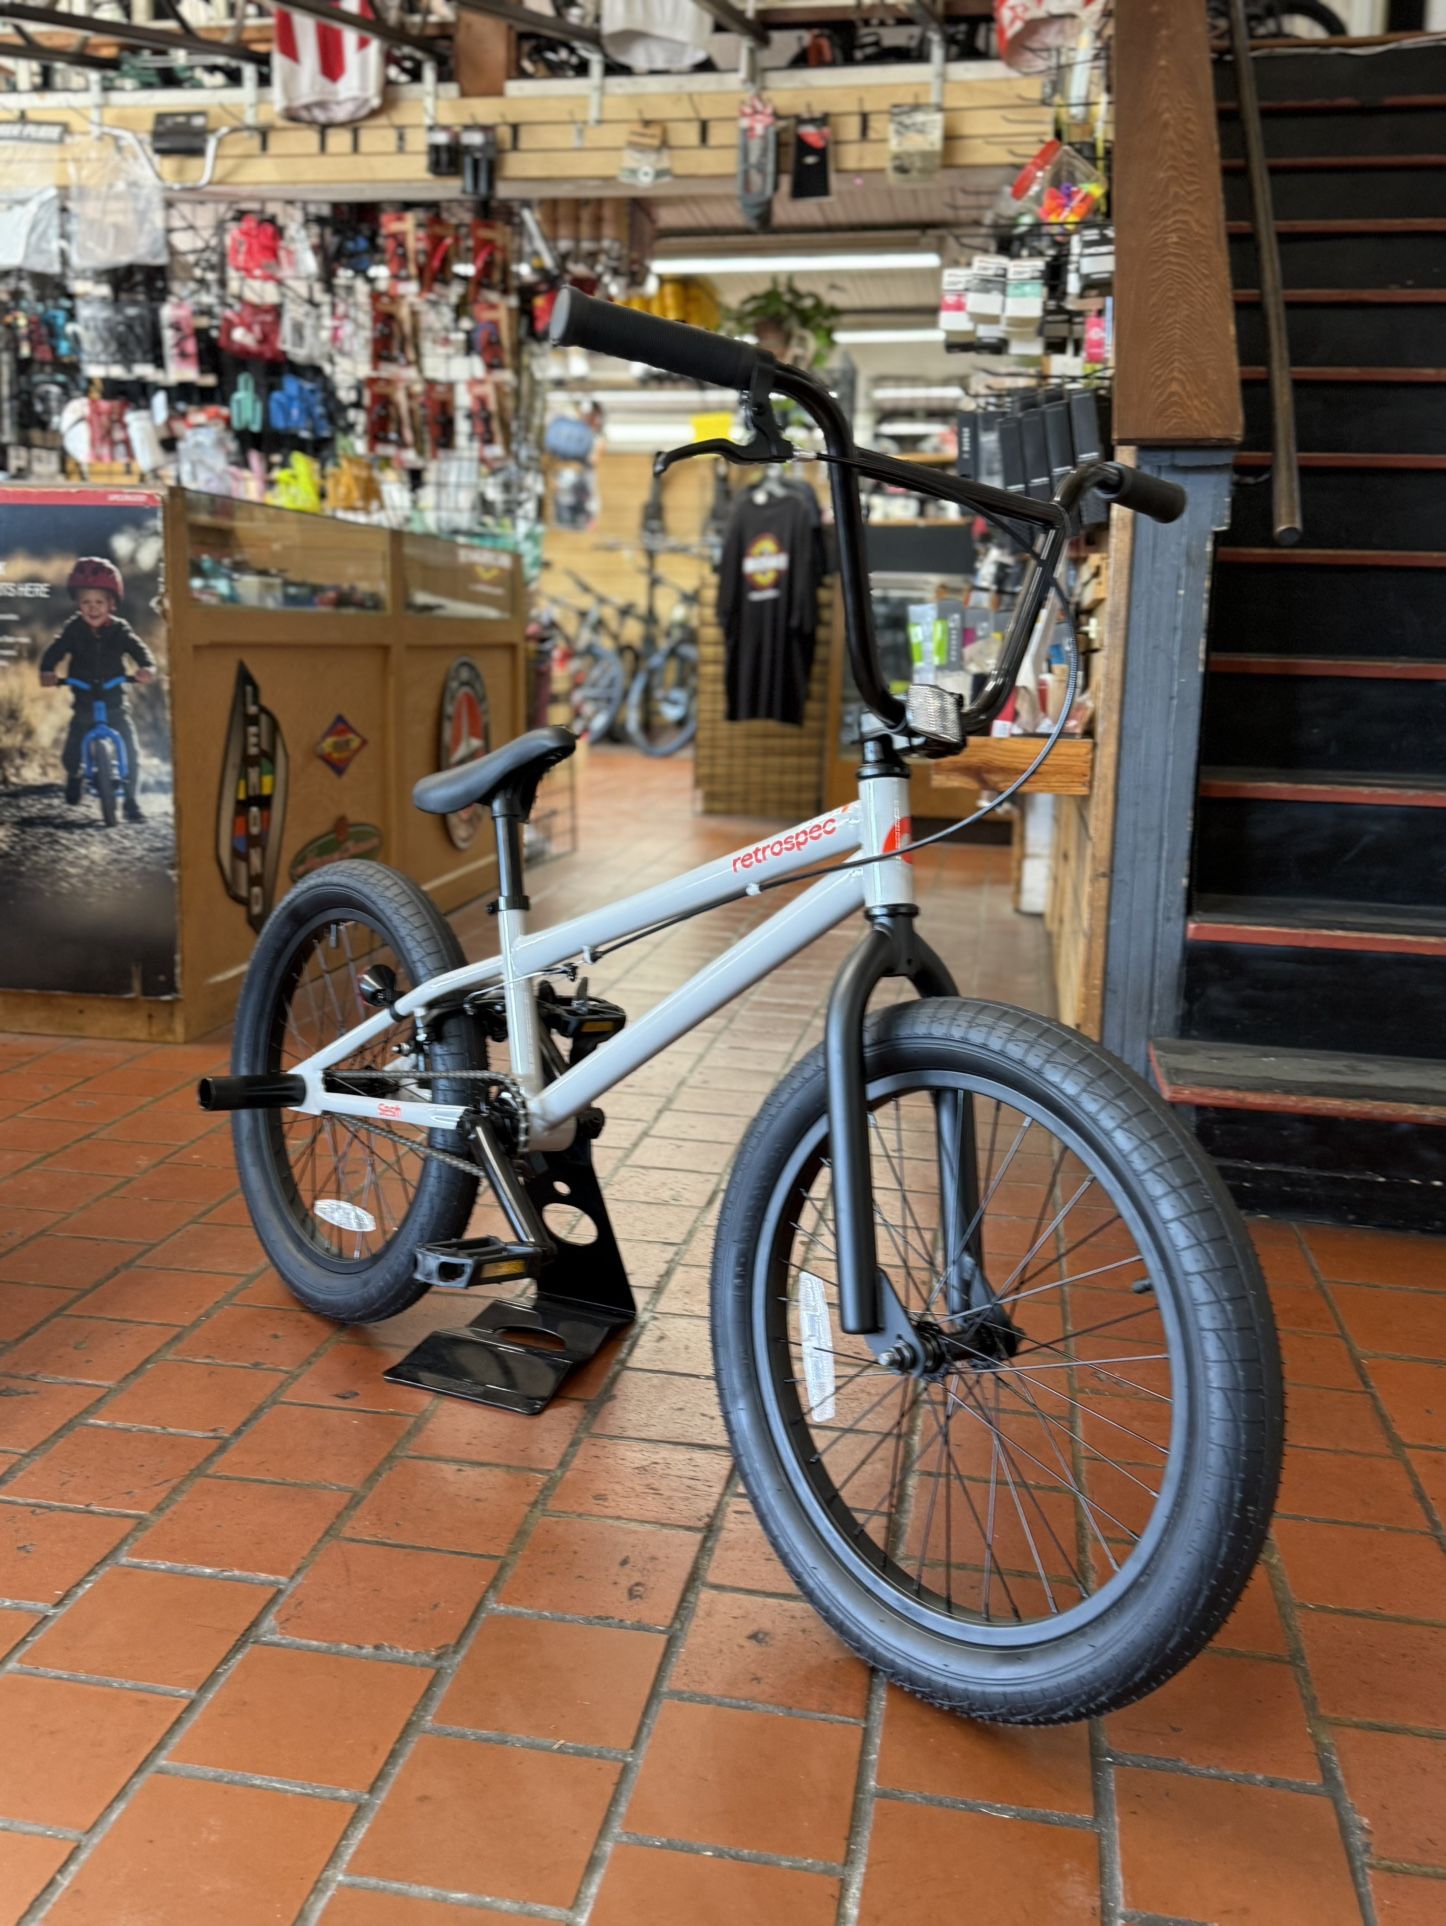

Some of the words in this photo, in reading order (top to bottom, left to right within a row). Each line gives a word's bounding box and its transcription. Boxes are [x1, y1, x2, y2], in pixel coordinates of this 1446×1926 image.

[17, 583, 51, 598] HERE
[245, 685, 263, 916] LEMOND
[731, 817, 838, 873] retrospec
